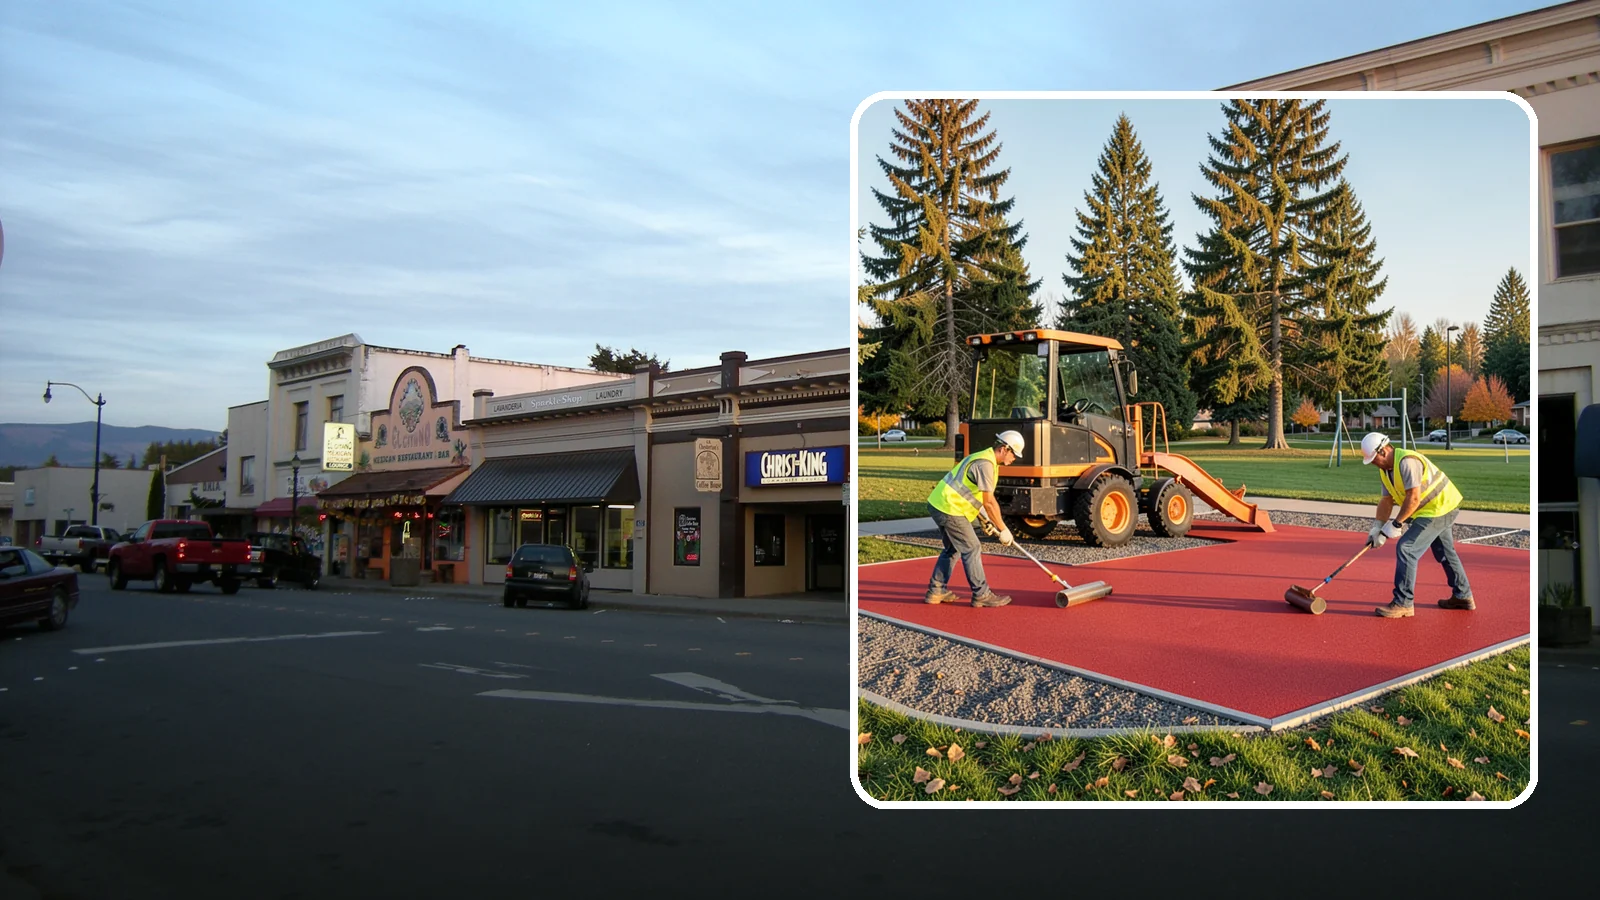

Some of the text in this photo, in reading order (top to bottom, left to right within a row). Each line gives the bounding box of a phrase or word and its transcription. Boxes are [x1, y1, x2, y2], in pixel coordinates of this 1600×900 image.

[561, 394, 583, 405] Shop
[595, 388, 623, 400] LAUNDRY
[493, 402, 522, 413] LAVANDERIA
[373, 454, 397, 464] MEXICAN
[397, 451, 434, 462] RESTAURANT
[438, 450, 450, 459] BAR
[760, 450, 827, 478] CHRIST KING
